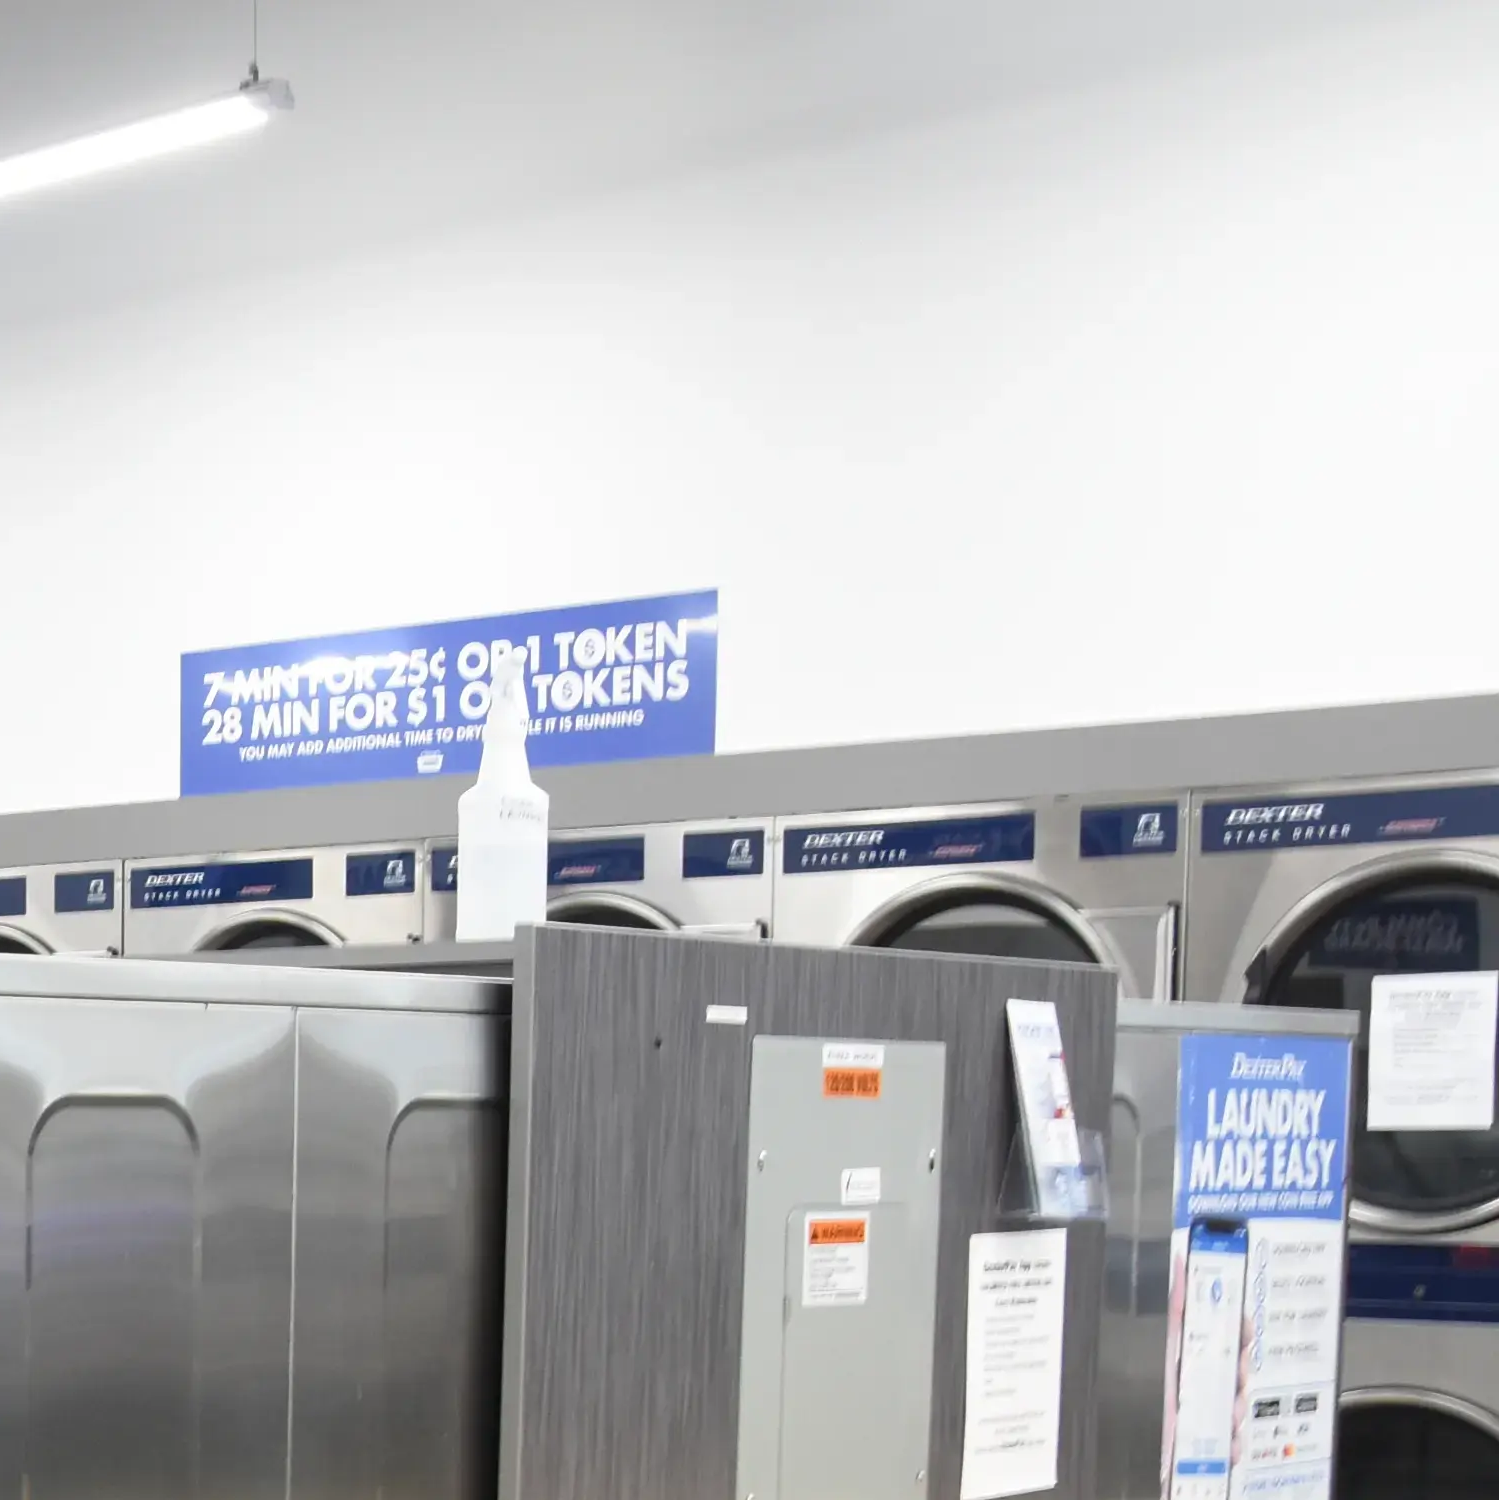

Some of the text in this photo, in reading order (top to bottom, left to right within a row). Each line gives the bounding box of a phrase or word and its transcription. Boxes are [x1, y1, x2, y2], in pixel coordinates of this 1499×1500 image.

[203, 671, 225, 708] 7
[230, 663, 301, 706] MIN
[384, 646, 446, 690] 25¢
[553, 618, 687, 672] TOKEN
[201, 660, 690, 745] 28 MIN FOR $1 TOKENS
[559, 715, 573, 734] IS
[575, 709, 645, 731] RUNNING
[239, 726, 454, 762] YOU MAY ADD ADDITIONAL TIME TO
[1224, 803, 1325, 827] DEXTER
[802, 829, 885, 850] DEXTER
[144, 871, 205, 888] DEXTER
[1206, 1087, 1327, 1140] LAUNDRY
[1188, 1138, 1337, 1193] MADE EASY
